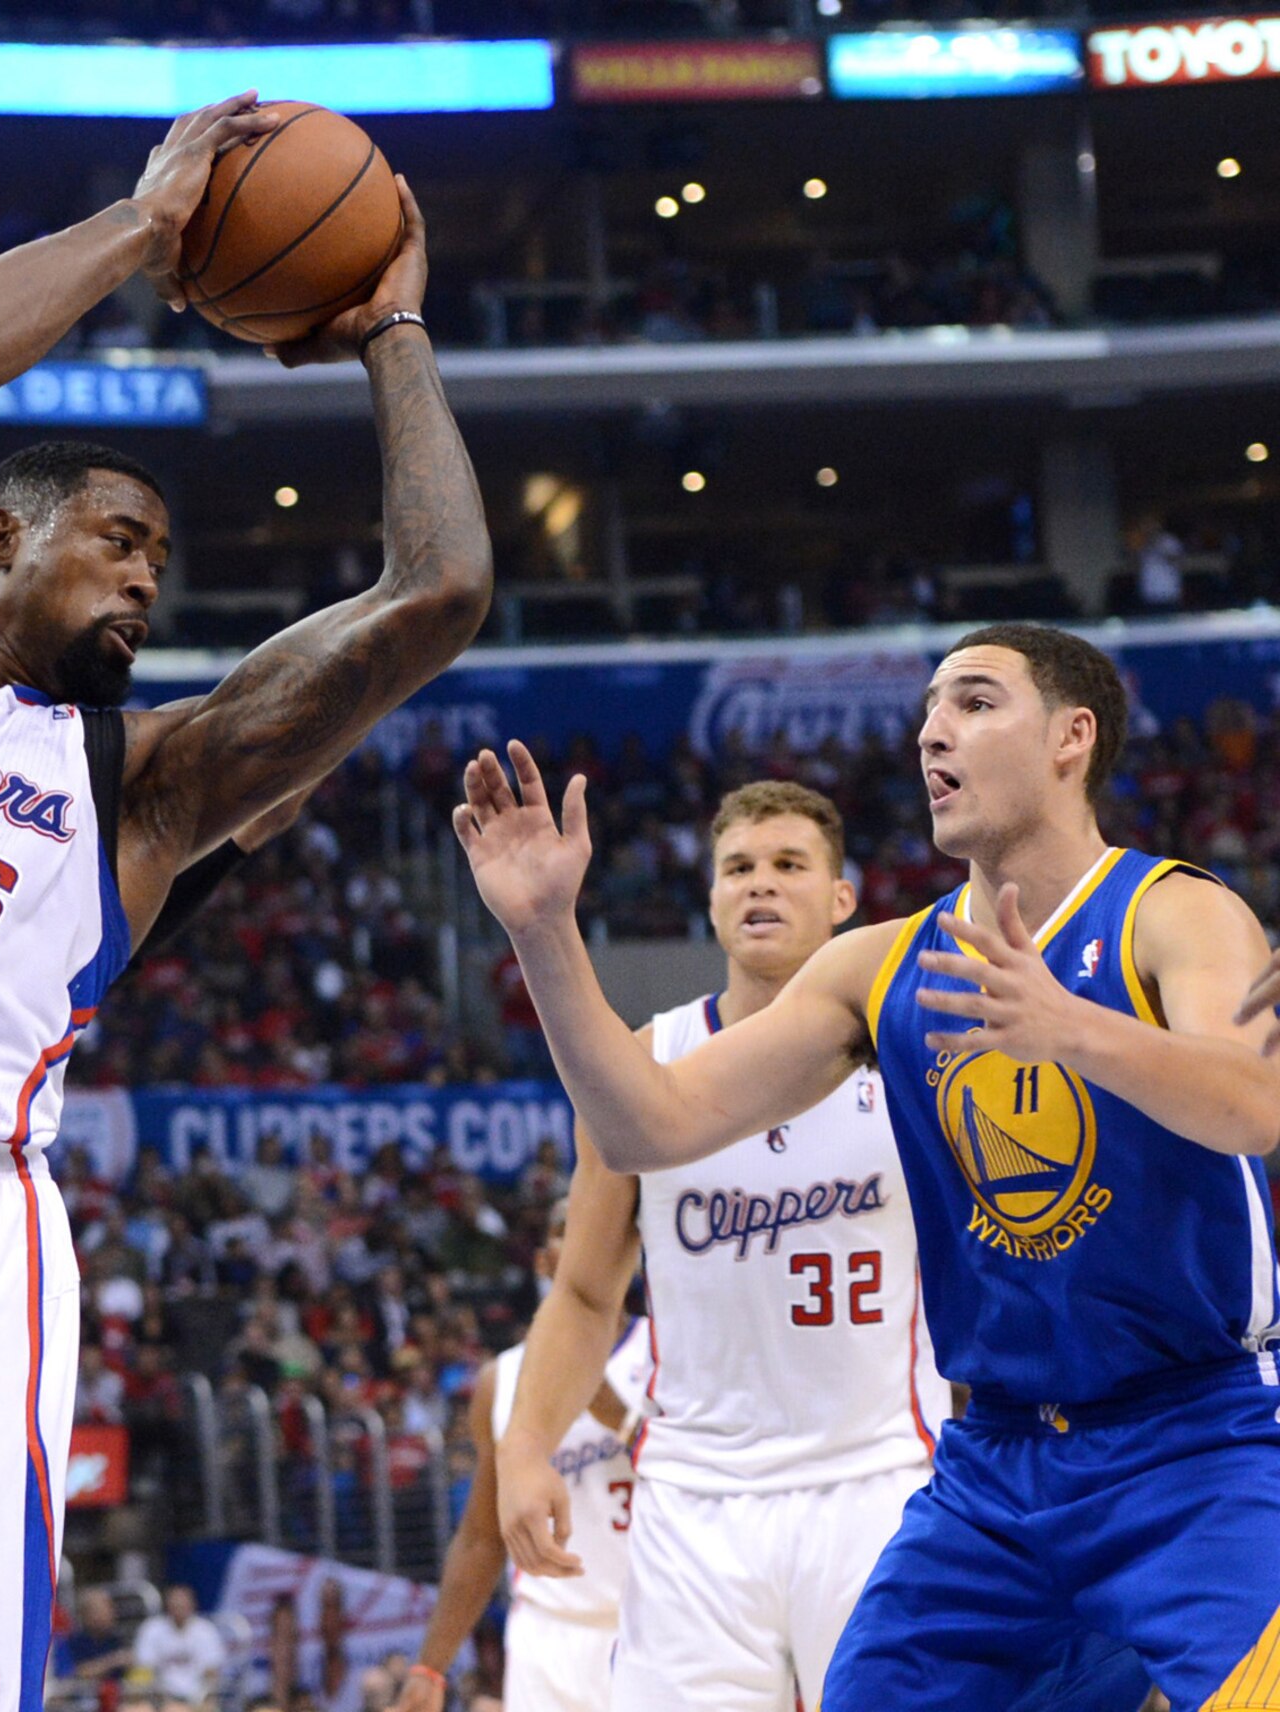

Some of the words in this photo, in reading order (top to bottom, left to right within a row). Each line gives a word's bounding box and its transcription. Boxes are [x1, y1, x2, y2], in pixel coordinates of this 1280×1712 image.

[22, 370, 203, 415] DELTA
[1012, 1065, 1040, 1115] 11
[675, 1172, 891, 1262] Clippers
[966, 1183, 1113, 1261] WARRIORS
[789, 1249, 884, 1326] 32
